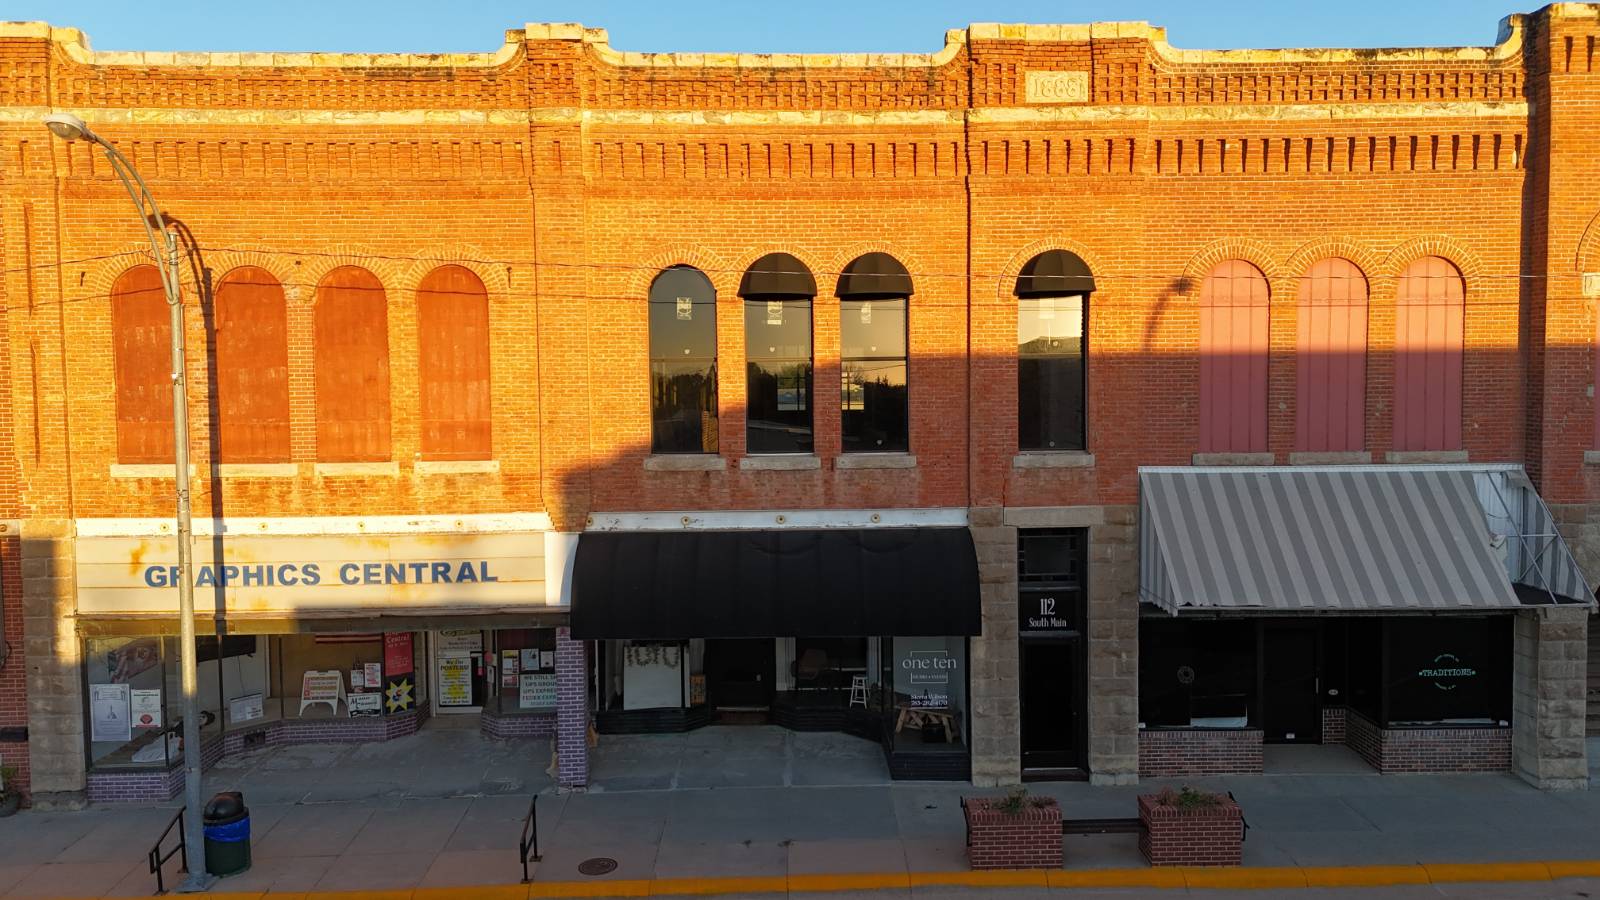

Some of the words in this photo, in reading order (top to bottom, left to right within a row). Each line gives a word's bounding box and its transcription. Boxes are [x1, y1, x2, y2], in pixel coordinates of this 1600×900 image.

[1033, 78, 1077, 98] 1888
[340, 561, 498, 584] CENTRAL
[1040, 598, 1056, 615] 112
[1028, 616, 1049, 628] South
[1050, 616, 1067, 628] Main
[902, 658, 930, 669] one
[933, 657, 957, 669] ten
[1422, 668, 1472, 677] TRADITIONS
